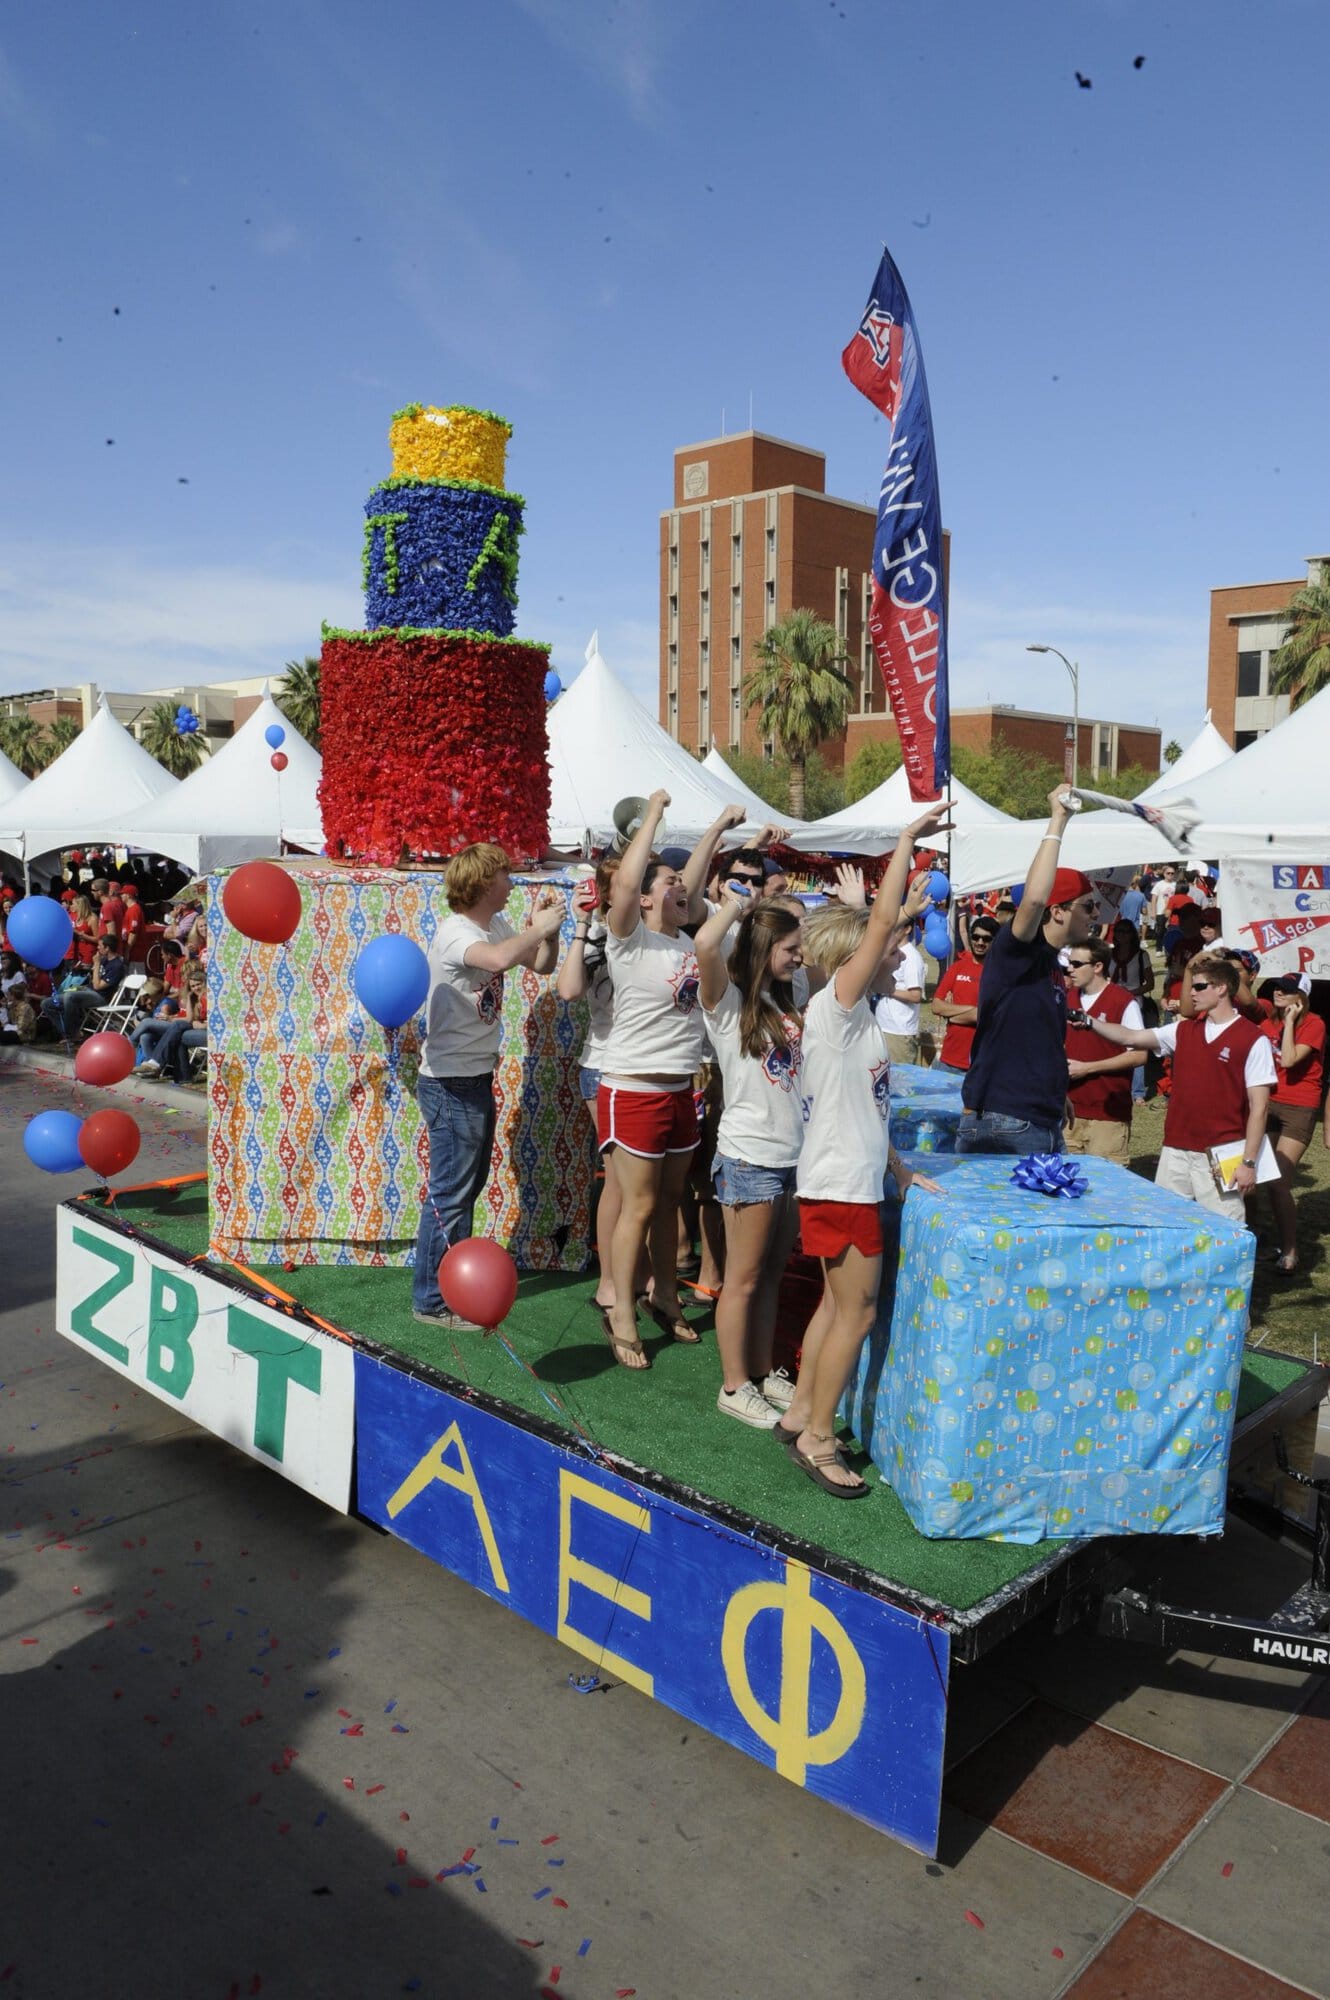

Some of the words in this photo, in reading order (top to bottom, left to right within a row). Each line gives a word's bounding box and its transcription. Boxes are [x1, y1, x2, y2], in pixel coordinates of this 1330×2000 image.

[1262, 916, 1316, 948] Aged
[71, 1226, 322, 1463] ZBT
[1253, 1637, 1330, 1665] HAULR
